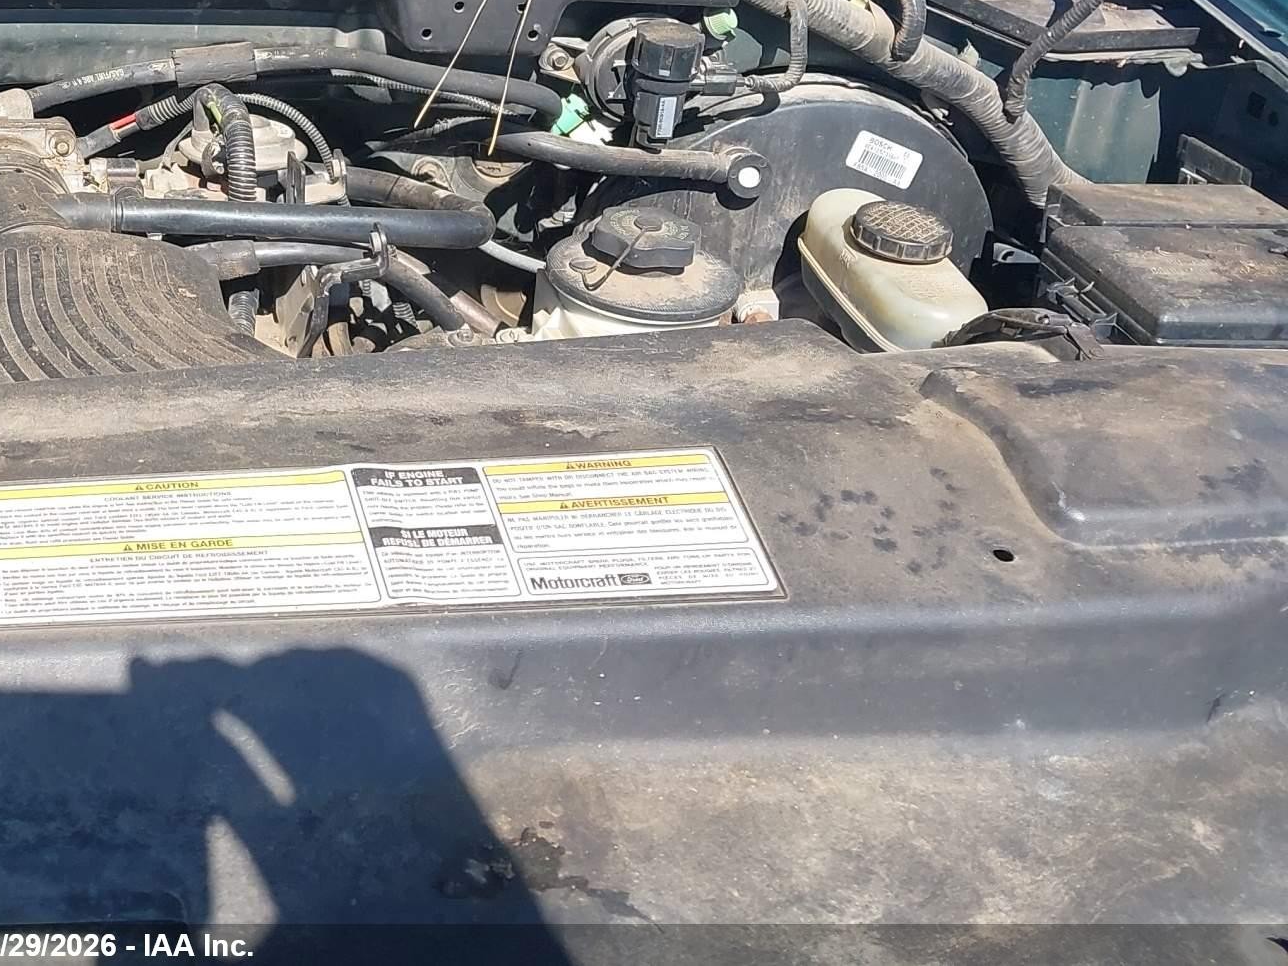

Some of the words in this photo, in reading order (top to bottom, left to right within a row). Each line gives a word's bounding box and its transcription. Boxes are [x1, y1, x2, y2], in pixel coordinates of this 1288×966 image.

[869, 137, 892, 151] BOSCH
[575, 460, 632, 470] WARNING
[385, 470, 394, 480] IF
[398, 470, 445, 480] ENGINE
[145, 481, 199, 491] CAUTION
[370, 478, 404, 488] FAILS
[406, 478, 423, 487] TO
[426, 477, 464, 486] START
[571, 496, 670, 509] AVERTISSEMENT
[401, 529, 411, 539] SI
[412, 530, 425, 539] LE
[426, 528, 469, 538] MOTEUR
[136, 541, 167, 551] MISE
[170, 541, 187, 549] EN
[191, 539, 234, 548] GARDE
[421, 538, 437, 547] DE
[530, 573, 619, 590] Motorcraft
